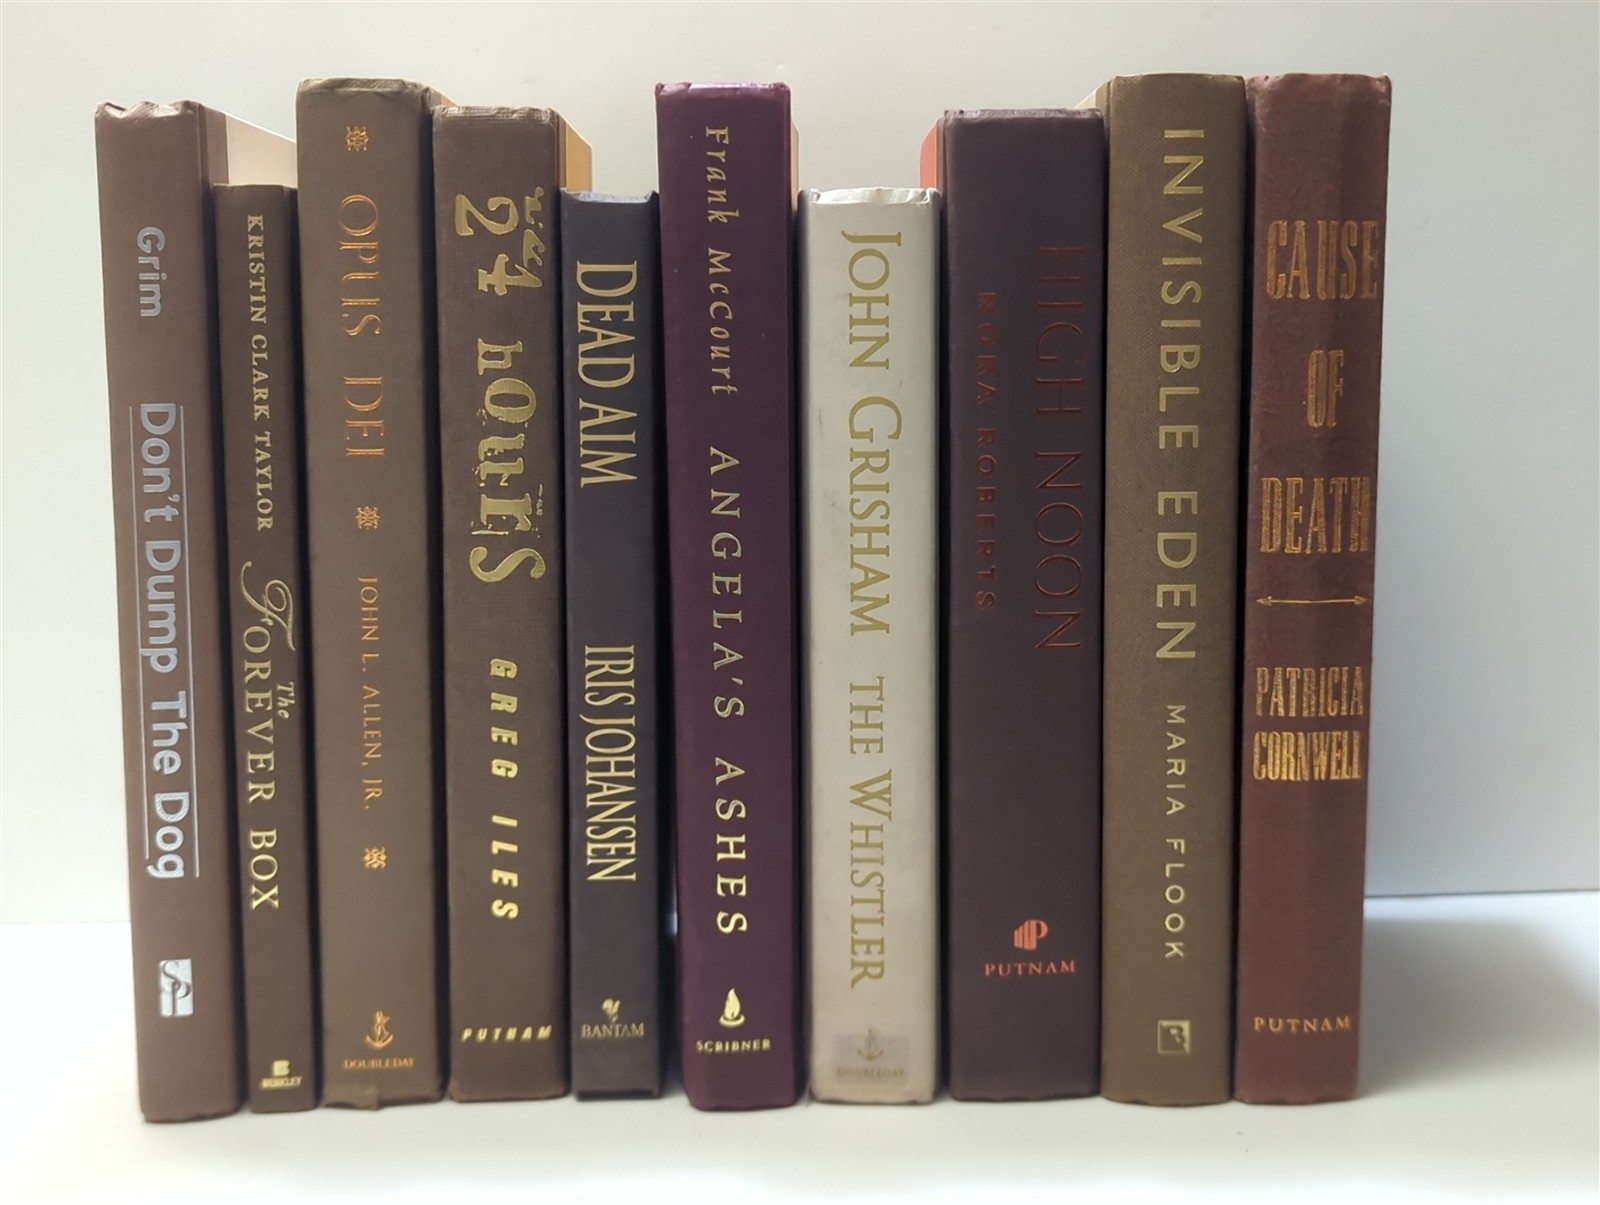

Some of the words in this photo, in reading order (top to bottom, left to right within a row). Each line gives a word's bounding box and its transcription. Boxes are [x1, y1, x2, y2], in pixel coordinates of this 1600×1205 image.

[705, 126, 739, 223] Frank
[136, 226, 168, 317] Grim
[247, 213, 267, 325] KRISTIN
[339, 192, 383, 337] OPUS
[454, 188, 545, 296] 24
[1266, 219, 1378, 300] CAUSE
[576, 260, 637, 389] DEAD
[707, 247, 738, 396] McCourt
[1036, 246, 1084, 416] HIGH
[1158, 128, 1204, 450] INVISIBLE
[251, 334, 270, 422] CLARK
[976, 291, 996, 405] NORA
[1307, 350, 1344, 427] OF
[140, 402, 180, 523] Don't
[344, 375, 385, 458] DEI
[579, 397, 638, 489] AIM
[254, 431, 275, 532] TAYLOR
[846, 395, 901, 636] GRISHAM
[976, 428, 995, 610] ROBERTS
[1260, 476, 1371, 553] DEATH
[710, 446, 745, 719] ANGELA'S
[1036, 449, 1083, 650] NOON
[1155, 490, 1198, 659] EDEN
[140, 540, 183, 673] Dump
[357, 577, 381, 642] JOHN
[277, 681, 295, 719] The
[361, 652, 381, 672] L.
[583, 644, 635, 708] IRIS
[1256, 666, 1364, 717] PATRICIA
[152, 691, 187, 775] The
[362, 685, 382, 767] ALLEN,
[490, 659, 518, 779] GREG
[850, 675, 885, 756] THE
[1165, 704, 1187, 816] MARIA
[1252, 730, 1361, 781] CORNWELL
[147, 791, 189, 879] Dog
[363, 778, 383, 811] JR.
[580, 714, 637, 883] JOHANSEN
[248, 828, 280, 912] BOX
[491, 815, 519, 920] ILES
[715, 757, 748, 935] ASHES
[849, 767, 892, 989] WHISTLER
[1165, 838, 1187, 959] FLOOK
[984, 960, 1076, 977] PUTNAM
[343, 1057, 415, 1069] DOUBLEDAY
[461, 1026, 552, 1042] PUTNAM
[580, 1023, 645, 1038] BANTAM
[696, 1038, 771, 1053] SCRIBNER
[1254, 1016, 1352, 1033] PUTNAM
